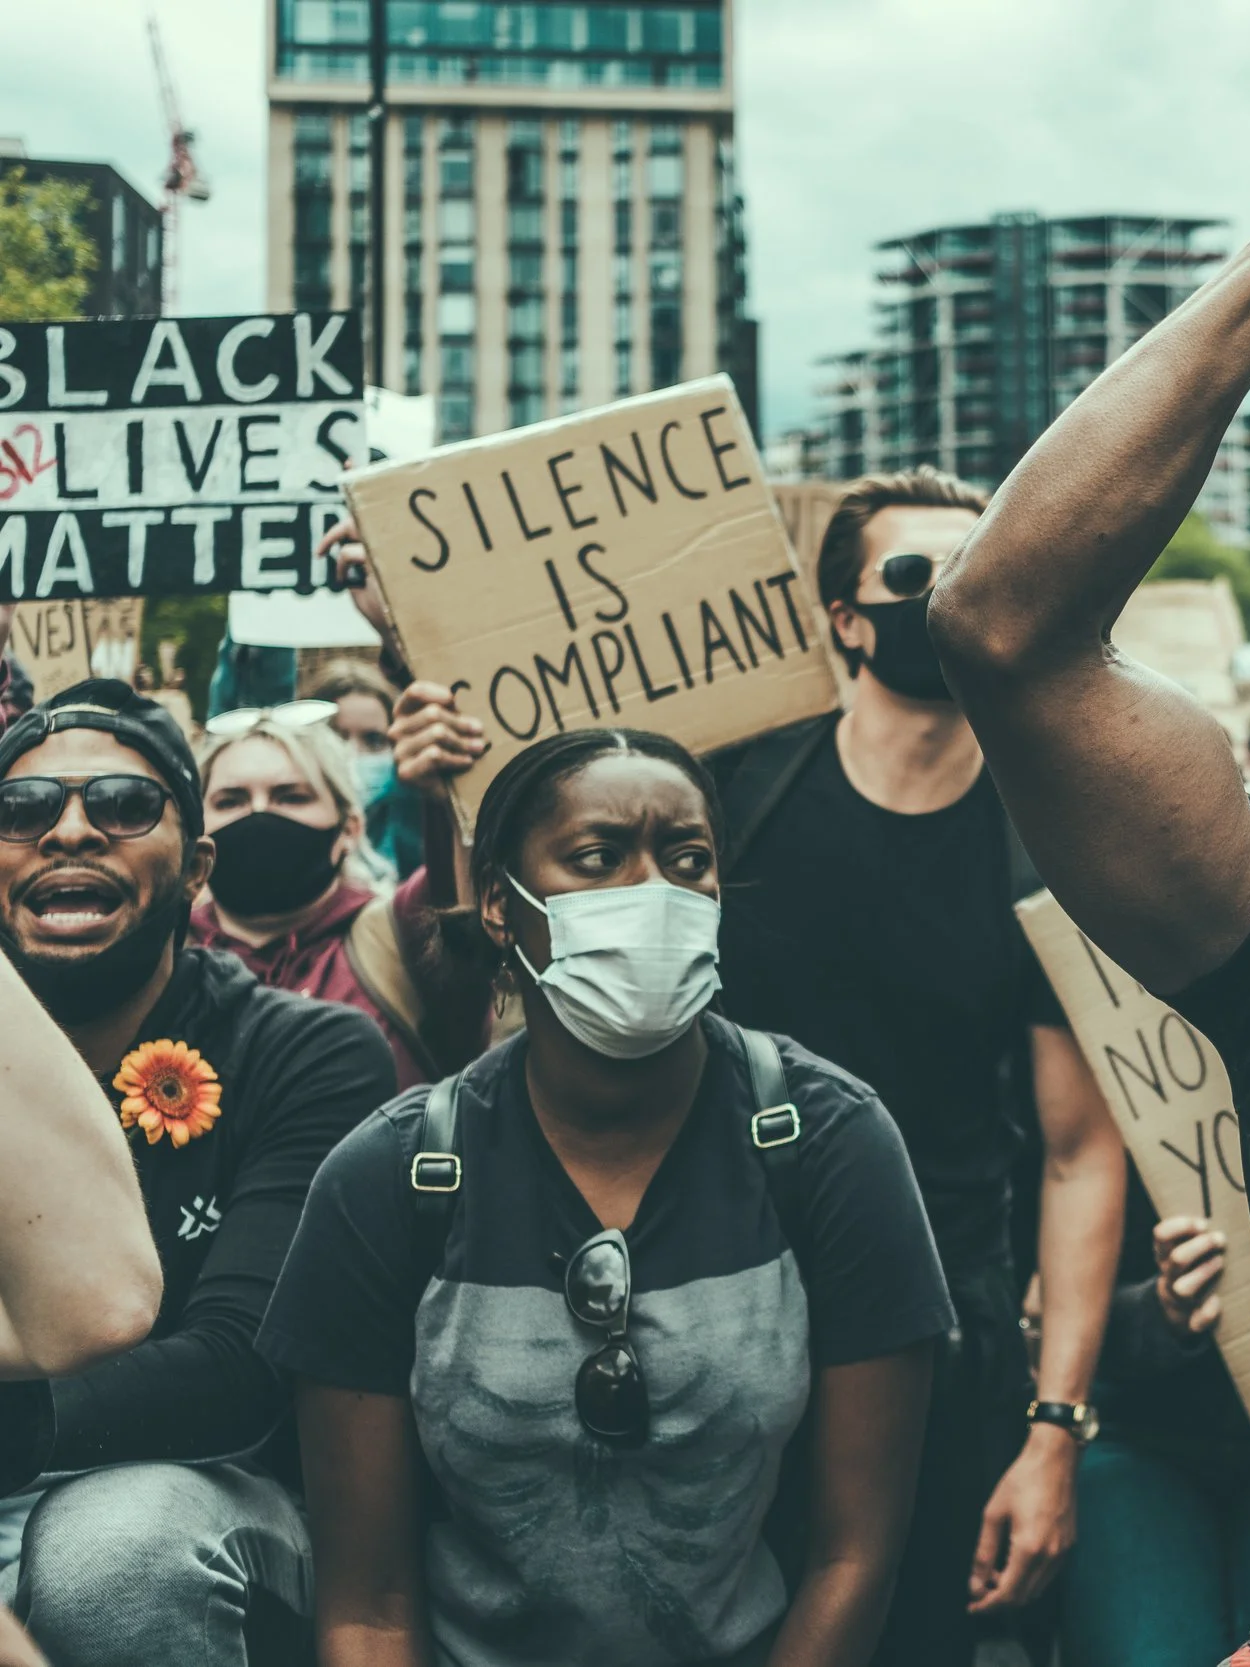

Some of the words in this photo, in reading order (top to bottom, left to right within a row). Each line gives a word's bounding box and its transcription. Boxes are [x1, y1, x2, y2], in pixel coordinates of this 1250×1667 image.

[54, 410, 359, 499] LIVES
[408, 406, 752, 573] SILENCE
[544, 543, 629, 632] IS
